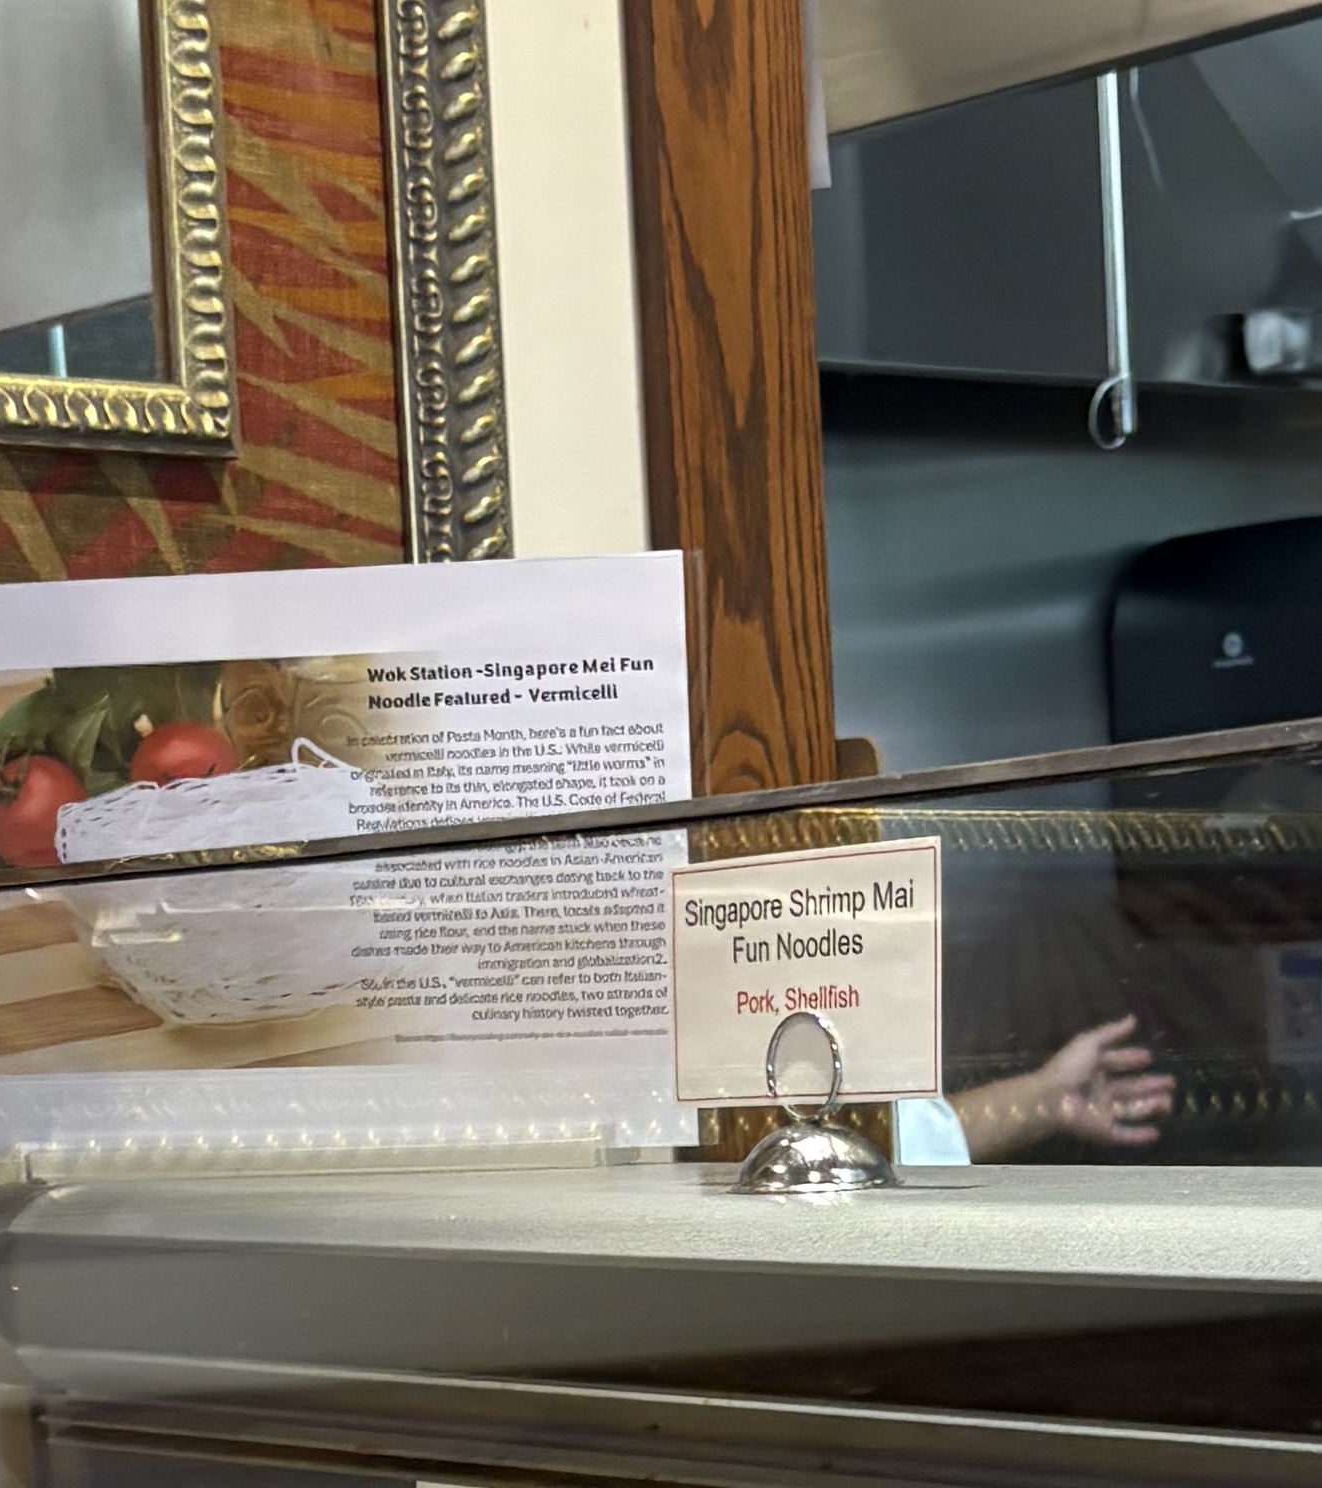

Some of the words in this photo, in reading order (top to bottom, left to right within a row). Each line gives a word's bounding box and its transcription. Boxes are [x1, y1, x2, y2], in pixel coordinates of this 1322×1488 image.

[367, 666, 407, 683] Wok
[410, 665, 473, 681] Station
[582, 657, 616, 673] Mei
[620, 657, 654, 672] Fun
[368, 694, 431, 709] Noodle
[435, 688, 511, 707] Featured
[528, 684, 618, 702] Vermicelli
[432, 731, 444, 743] of
[447, 731, 481, 743] Pasta
[483, 729, 526, 742] Month,
[569, 729, 576, 738] a
[579, 726, 599, 737] fun
[601, 725, 625, 736] fact
[629, 723, 664, 735] about
[386, 749, 444, 762] vermicelli
[447, 748, 496, 759] noodles
[499, 747, 509, 758] in
[513, 746, 532, 757] the
[565, 742, 601, 754] While
[604, 740, 664, 753] vermicelli
[458, 765, 472, 776] its
[475, 765, 510, 776] name
[512, 761, 565, 774] meaning
[654, 757, 665, 768] in
[370, 784, 428, 797] reference
[431, 783, 443, 794] to
[446, 782, 460, 793] its
[463, 781, 490, 794] thin,
[493, 778, 553, 793] elongated
[556, 778, 596, 790] shape,
[599, 775, 607, 788] it
[610, 775, 636, 787] took
[639, 776, 655, 786] on
[658, 776, 666, 785] a
[446, 800, 457, 811] in
[460, 799, 514, 810] America.
[517, 796, 539, 808] The
[542, 794, 567, 807] U.S.
[569, 793, 602, 805] Code
[605, 792, 616, 804] of
[620, 790, 666, 804] Federal
[375, 859, 442, 872] associated
[444, 859, 470, 870] with
[473, 858, 495, 869] rice
[499, 856, 548, 867] noodles
[550, 855, 561, 866] in
[399, 877, 421, 889] due
[424, 877, 436, 888] to
[439, 874, 485, 887] cultural
[489, 873, 553, 886] exchanges
[556, 871, 593, 884] dating
[596, 870, 626, 882] back
[629, 870, 640, 881] to
[644, 869, 664, 880] the
[505, 889, 548, 900] traders
[551, 888, 618, 900] introduced
[414, 908, 472, 922] vermicelli
[475, 908, 487, 919] to
[657, 903, 665, 914] it
[685, 897, 782, 930] Singapore
[789, 885, 866, 918] Shrimp
[873, 879, 914, 911] Mai
[415, 927, 437, 939] rice
[439, 926, 470, 938] flour,
[473, 926, 495, 937] and
[498, 924, 518, 935] the
[520, 924, 555, 935] name
[558, 922, 591, 933] stuck
[594, 921, 627, 933] when
[630, 920, 665, 931] these
[394, 944, 428, 956] made
[431, 943, 458, 955] their
[461, 944, 486, 955] way
[488, 943, 501, 953] to
[503, 940, 563, 952] American
[565, 938, 616, 950] kitchens
[619, 937, 666, 950] through
[733, 937, 770, 964] Fun
[777, 928, 864, 961] Noodles
[478, 957, 549, 971] immigration
[552, 956, 575, 968] and
[397, 977, 416, 989] the
[522, 975, 544, 985] can
[548, 973, 575, 985] refer
[578, 973, 591, 984] to
[594, 972, 621, 984] both
[387, 996, 421, 1008] pasta
[424, 994, 447, 1006] and
[449, 993, 497, 1005] delicate
[500, 992, 523, 1003] rice
[526, 990, 578, 1003] noodles,
[581, 990, 604, 1000] two
[607, 988, 653, 999] strands
[655, 987, 667, 998] of
[737, 988, 779, 1016] Pork,
[785, 985, 860, 1011] Shellfish
[472, 1009, 520, 1021] culinary
[523, 1007, 564, 1020] history
[567, 1006, 612, 1017] twisted
[615, 1005, 669, 1018] together.
